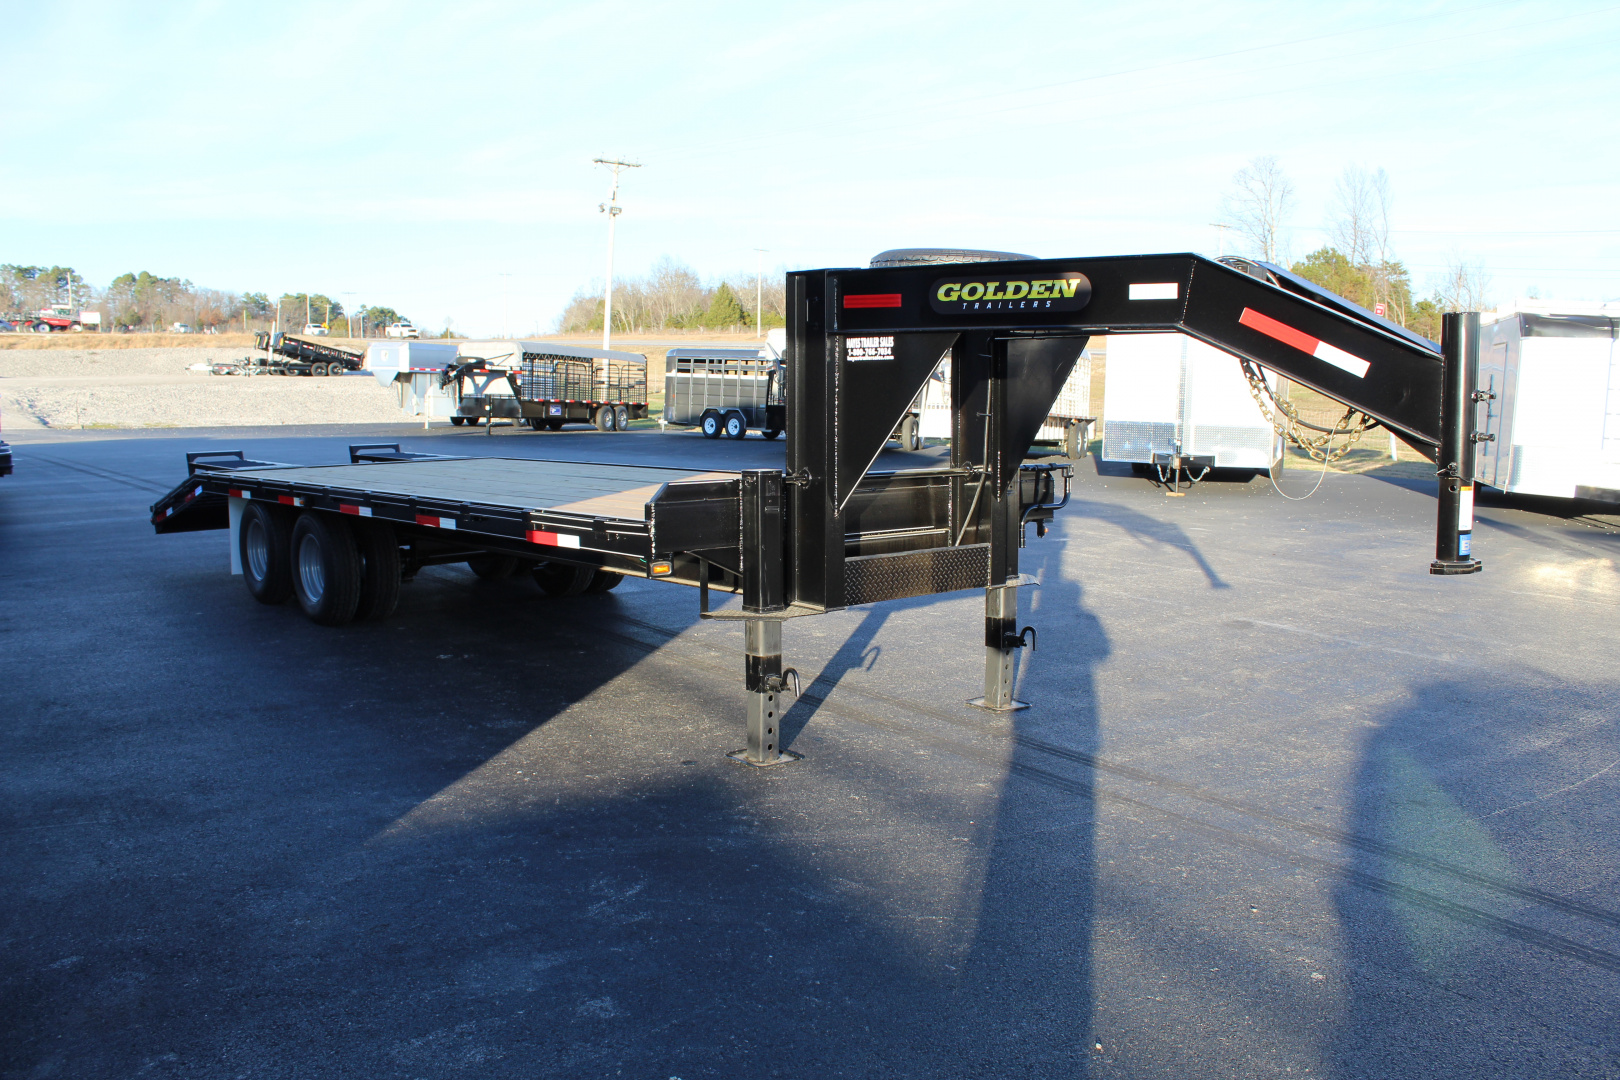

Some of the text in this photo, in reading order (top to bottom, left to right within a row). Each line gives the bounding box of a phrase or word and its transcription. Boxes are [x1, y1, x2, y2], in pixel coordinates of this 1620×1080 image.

[937, 278, 1081, 302] GOLDEN
[962, 300, 1052, 310] TRAILERS
[846, 336, 894, 349] HAYES TRAILER SALES
